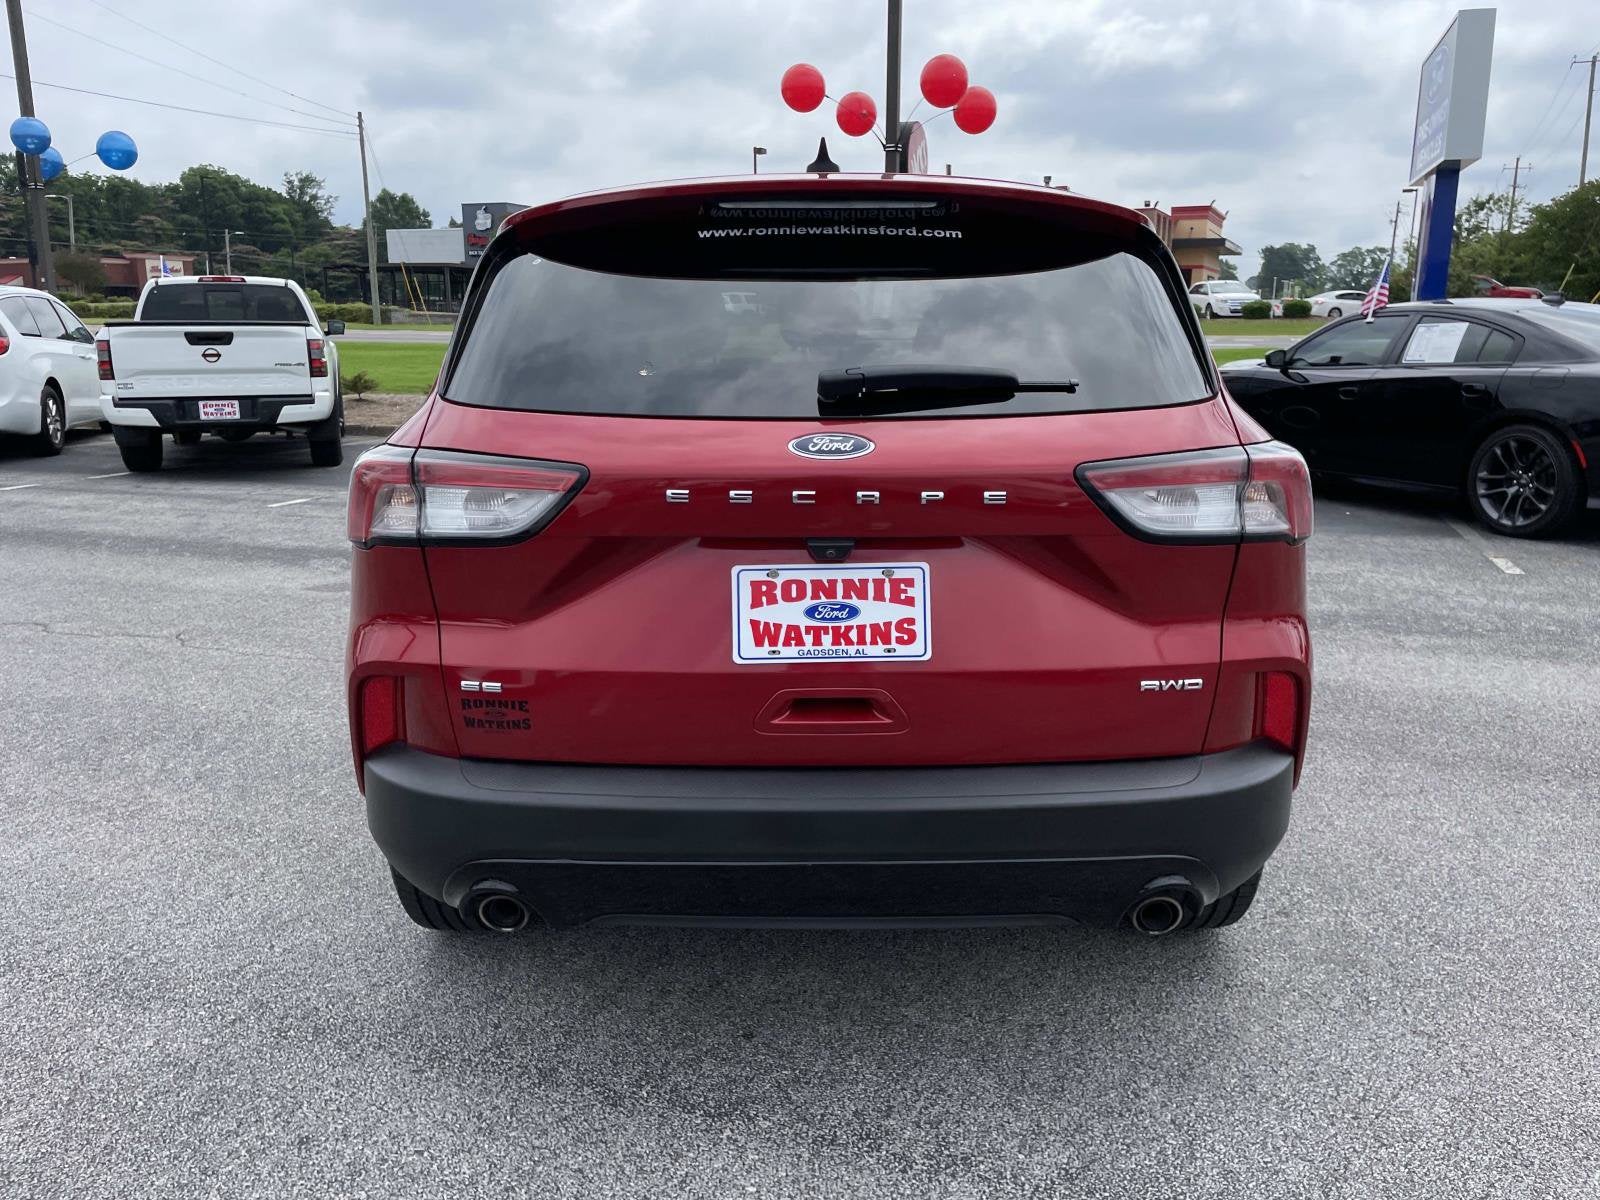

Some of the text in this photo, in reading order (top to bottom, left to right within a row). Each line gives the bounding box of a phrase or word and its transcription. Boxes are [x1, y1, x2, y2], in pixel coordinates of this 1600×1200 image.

[697, 225, 963, 239] www.ronniewatkinsford.com
[808, 436, 855, 451] Ford
[666, 489, 1007, 504] ESCAPE
[750, 577, 916, 609] RONNIE
[814, 604, 849, 619] Ford
[750, 617, 917, 648] WATKINS
[797, 648, 868, 657] GADSDEN, AL
[460, 680, 502, 692] SE
[1140, 678, 1203, 692] AWD
[461, 698, 529, 712] RONNIE
[463, 716, 531, 730] WATKINS
